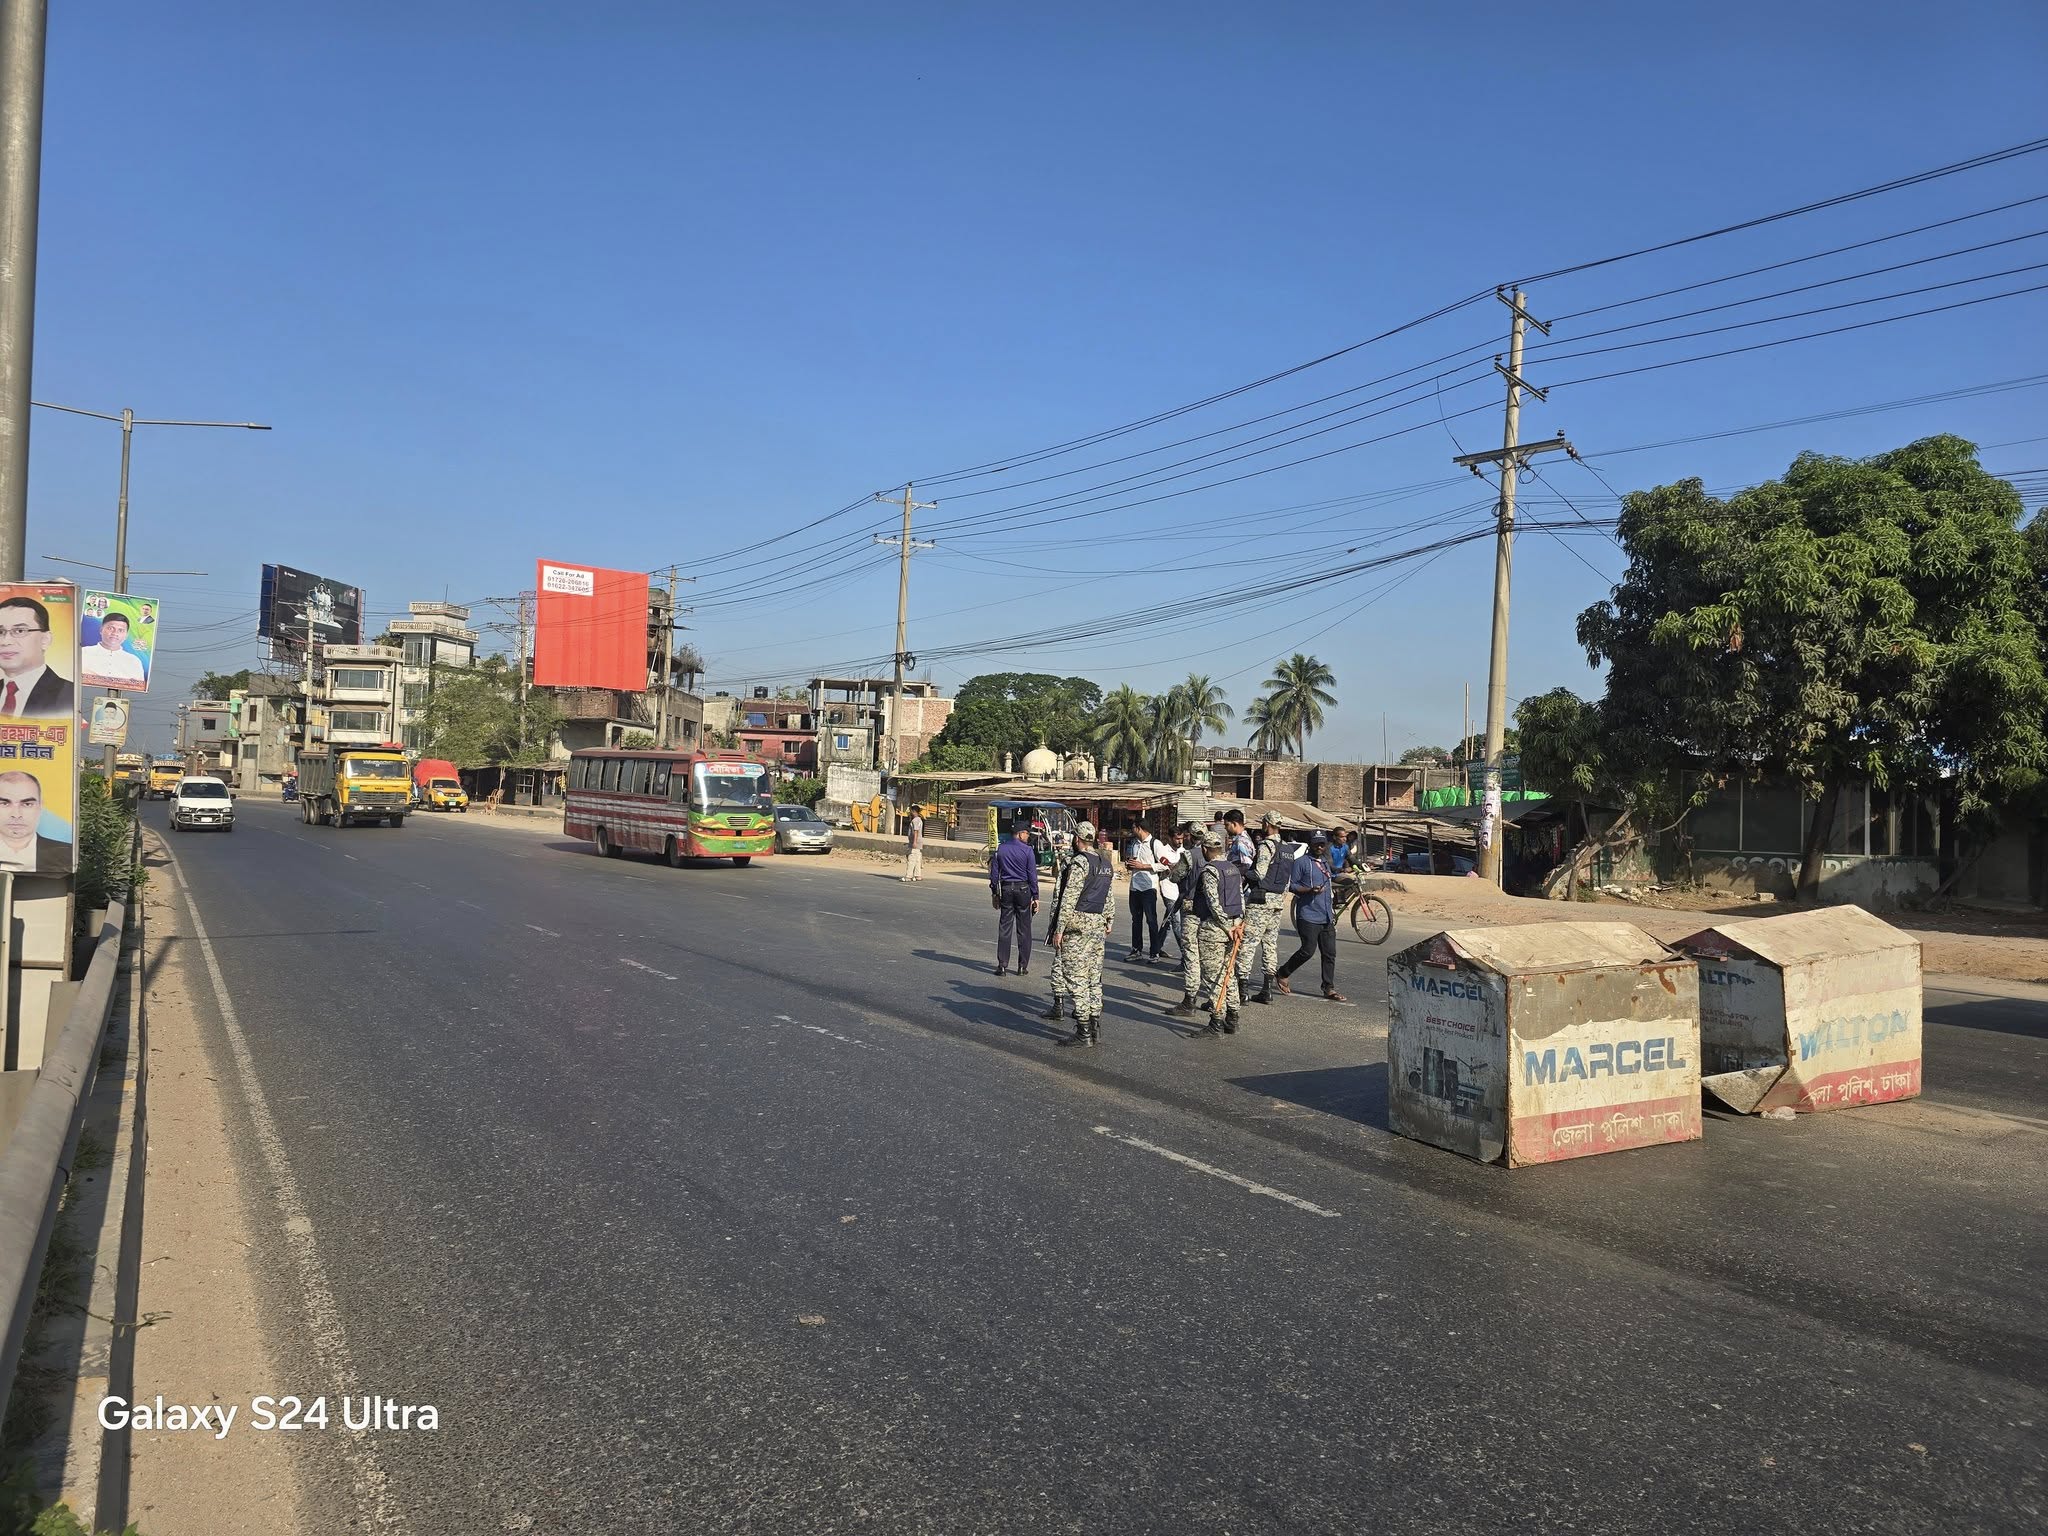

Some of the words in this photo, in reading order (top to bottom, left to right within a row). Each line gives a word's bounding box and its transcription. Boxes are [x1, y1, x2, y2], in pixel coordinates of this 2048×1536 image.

[20, 742, 54, 760] নিন
[1411, 975, 1488, 1003] MARCEL
[1426, 1016, 1446, 1026] BEST
[1447, 1021, 1476, 1032] CHOICE
[1799, 1010, 1909, 1061] WALTON
[1525, 1037, 1686, 1087] MARCEL
[1880, 1072, 1912, 1095] ঢাকা
[1552, 1121, 1595, 1148] জেলা
